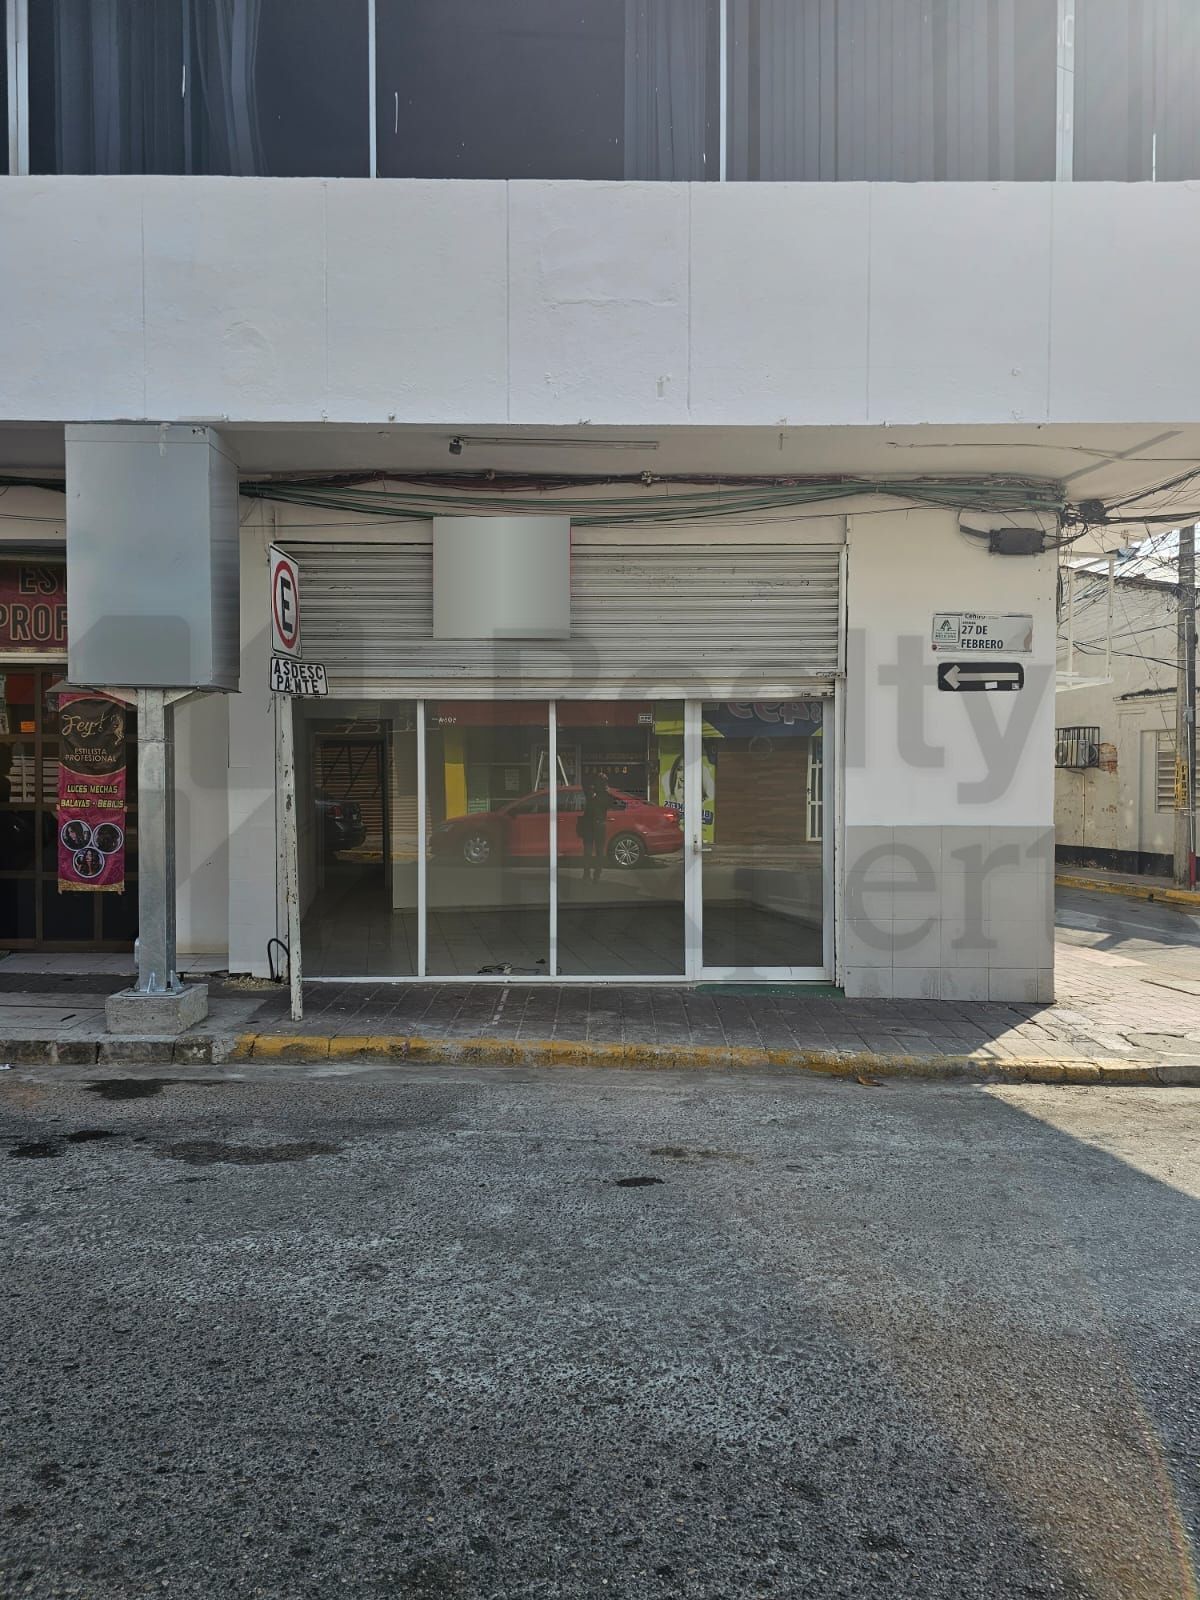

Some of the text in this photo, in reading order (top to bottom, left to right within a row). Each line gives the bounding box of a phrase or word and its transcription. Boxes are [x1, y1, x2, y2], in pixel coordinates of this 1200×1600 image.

[19, 566, 67, 595] ES
[280, 576, 293, 633] E
[961, 625, 973, 635] 27
[975, 625, 988, 635] DE
[961, 638, 1004, 649] FEBRERO
[74, 747, 107, 755] ESTILISTA
[65, 754, 117, 762] PROFESIONAL
[66, 784, 118, 794] LUCES MECHAS
[60, 799, 90, 808] BALAYAS
